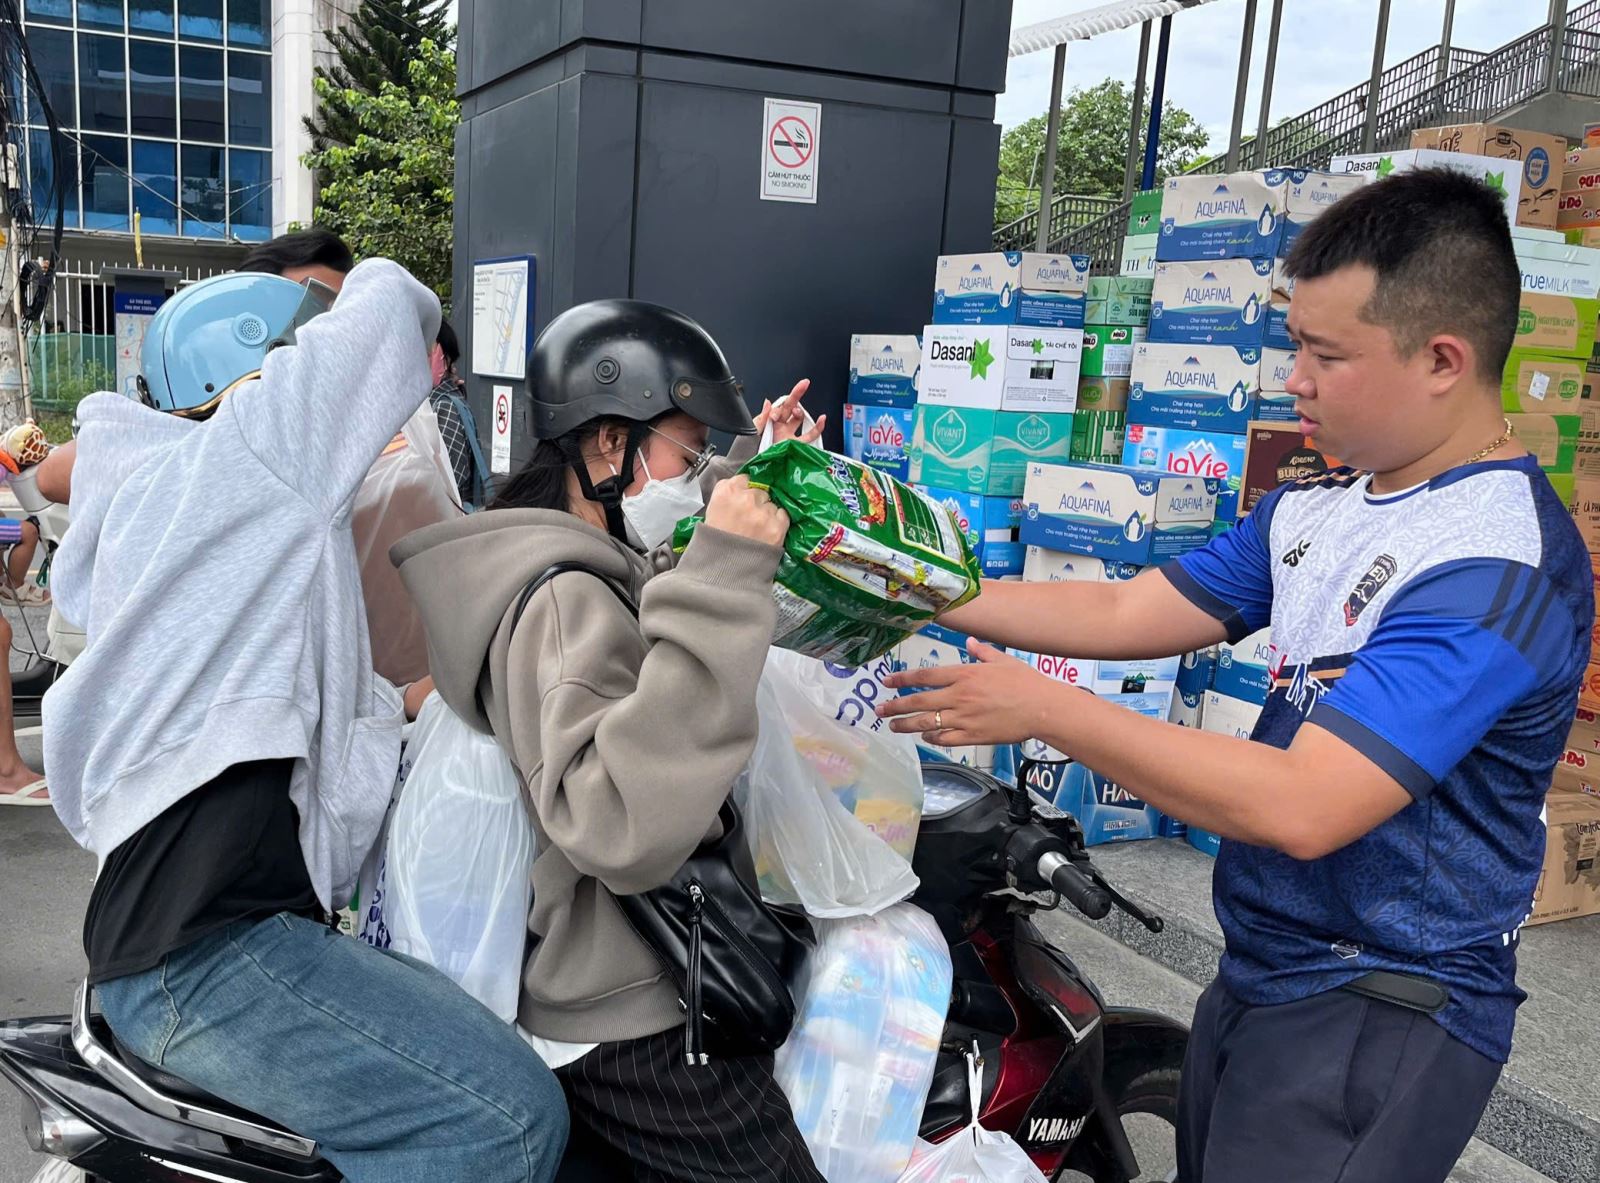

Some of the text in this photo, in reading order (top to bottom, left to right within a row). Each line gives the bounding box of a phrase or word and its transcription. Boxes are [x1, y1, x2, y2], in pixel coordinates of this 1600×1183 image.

[1345, 157, 1382, 173] Dasani
[1293, 187, 1301, 195] 24
[1195, 199, 1246, 219] AQUAFINA
[1036, 267, 1071, 281] AQUAFINA
[958, 277, 994, 291] AQUAFINA
[1183, 287, 1232, 304] AQUAFINA
[931, 339, 977, 361] Dasani
[1138, 346, 1147, 354] 24
[871, 357, 905, 372] AQUAFINA
[1164, 370, 1217, 389] AQUAFINA
[869, 424, 903, 446] laVie
[937, 428, 963, 439] VIVANT
[1167, 450, 1229, 478] laVie
[1059, 493, 1112, 518] AQUAFINA
[1168, 494, 1202, 512] AQUAFINA
[1206, 498, 1213, 506] 24
[1028, 1115, 1086, 1141] YAMAHA
